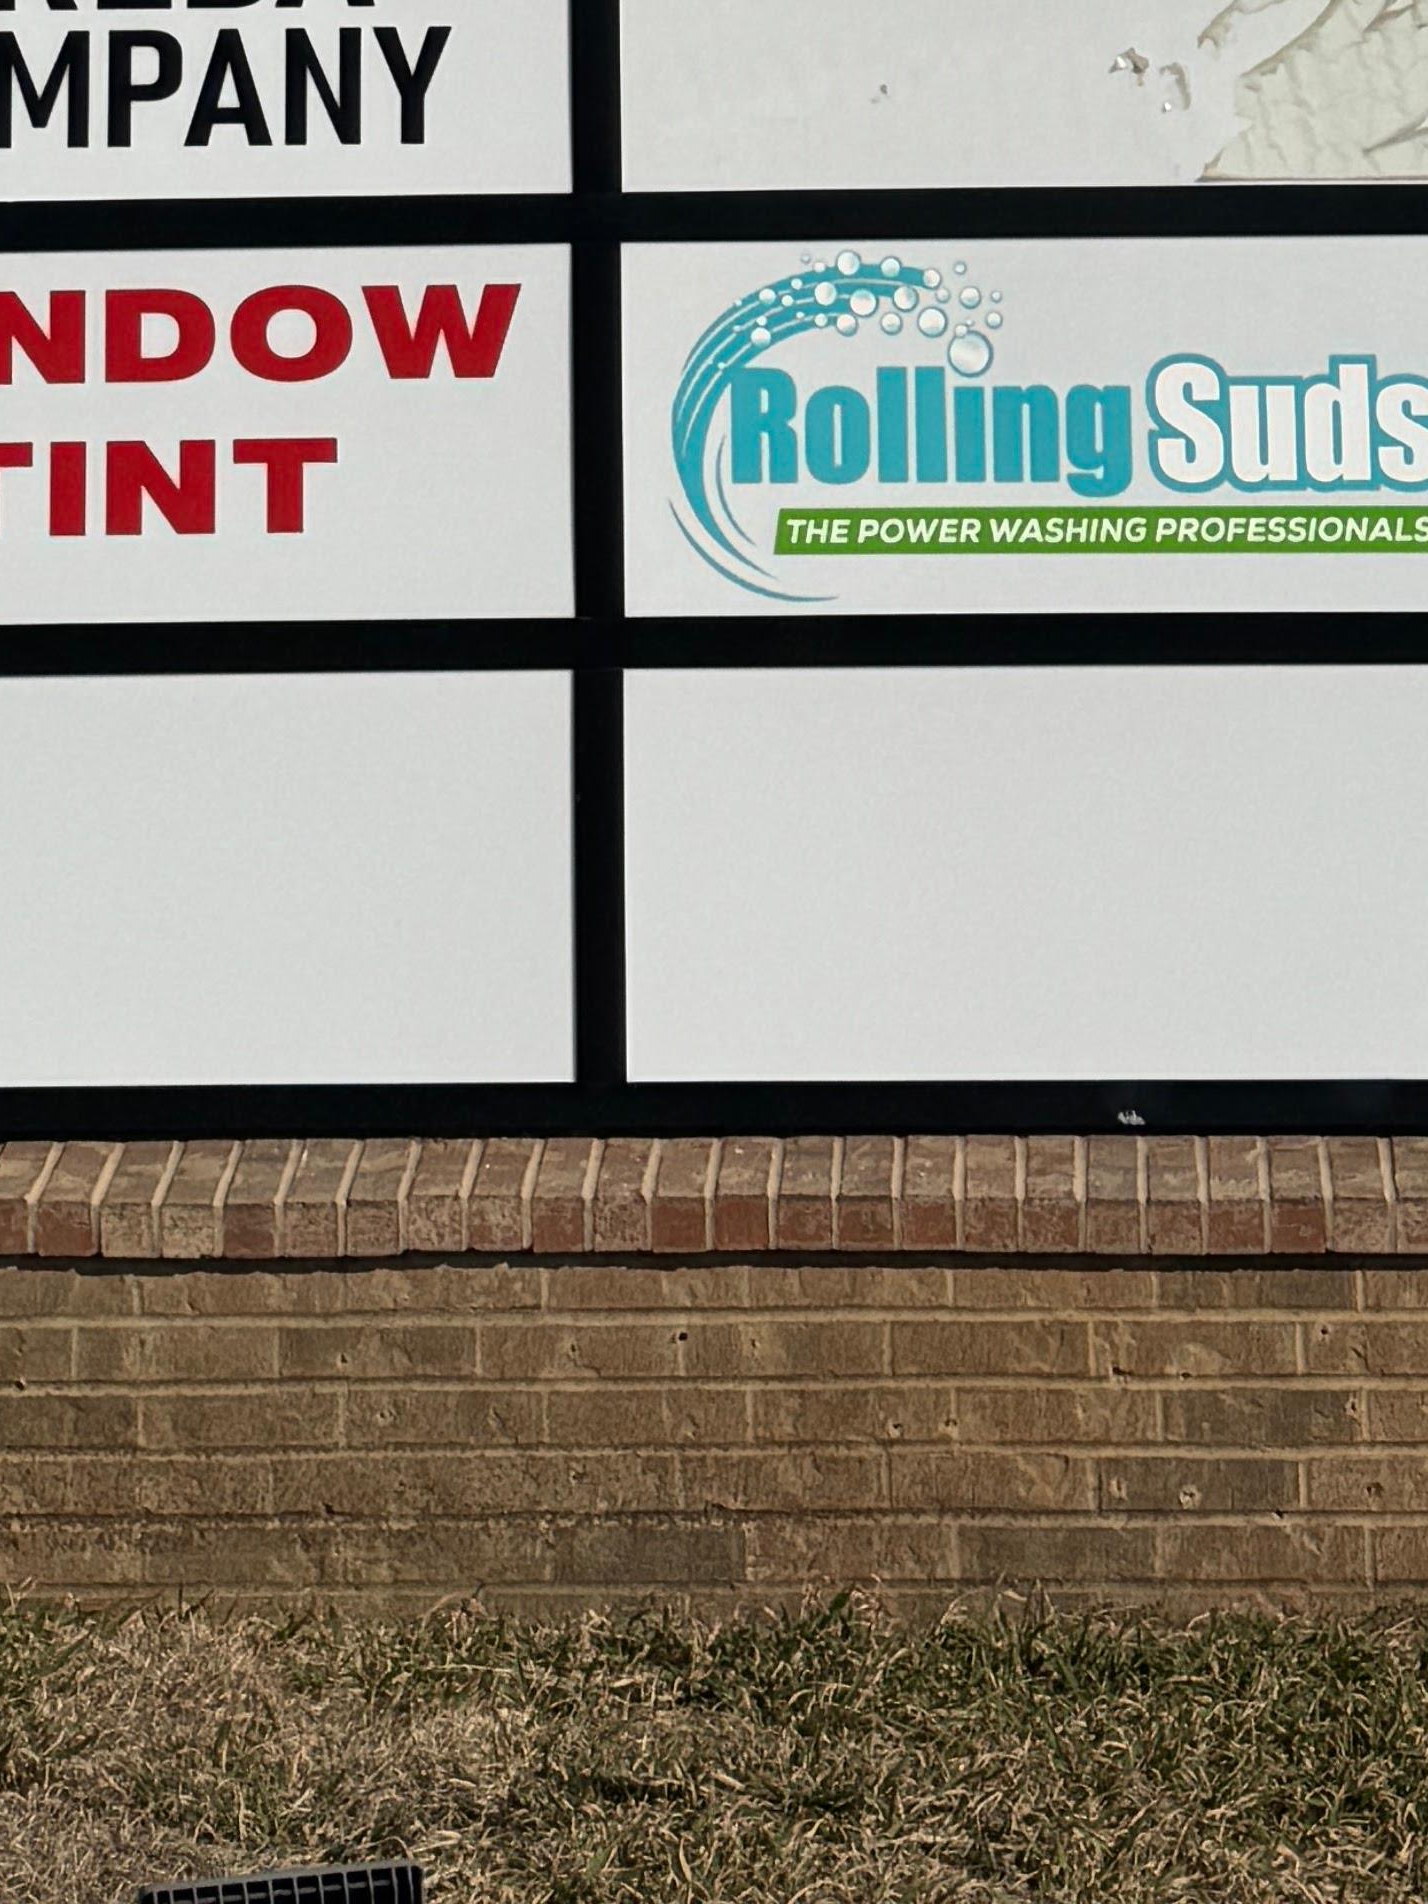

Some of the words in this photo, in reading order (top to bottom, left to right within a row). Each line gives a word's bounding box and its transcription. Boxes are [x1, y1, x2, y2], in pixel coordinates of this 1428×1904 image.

[728, 364, 1134, 497] Rolling
[786, 518, 850, 545] THE
[857, 517, 982, 545] POWER
[990, 517, 1148, 544] WASHING
